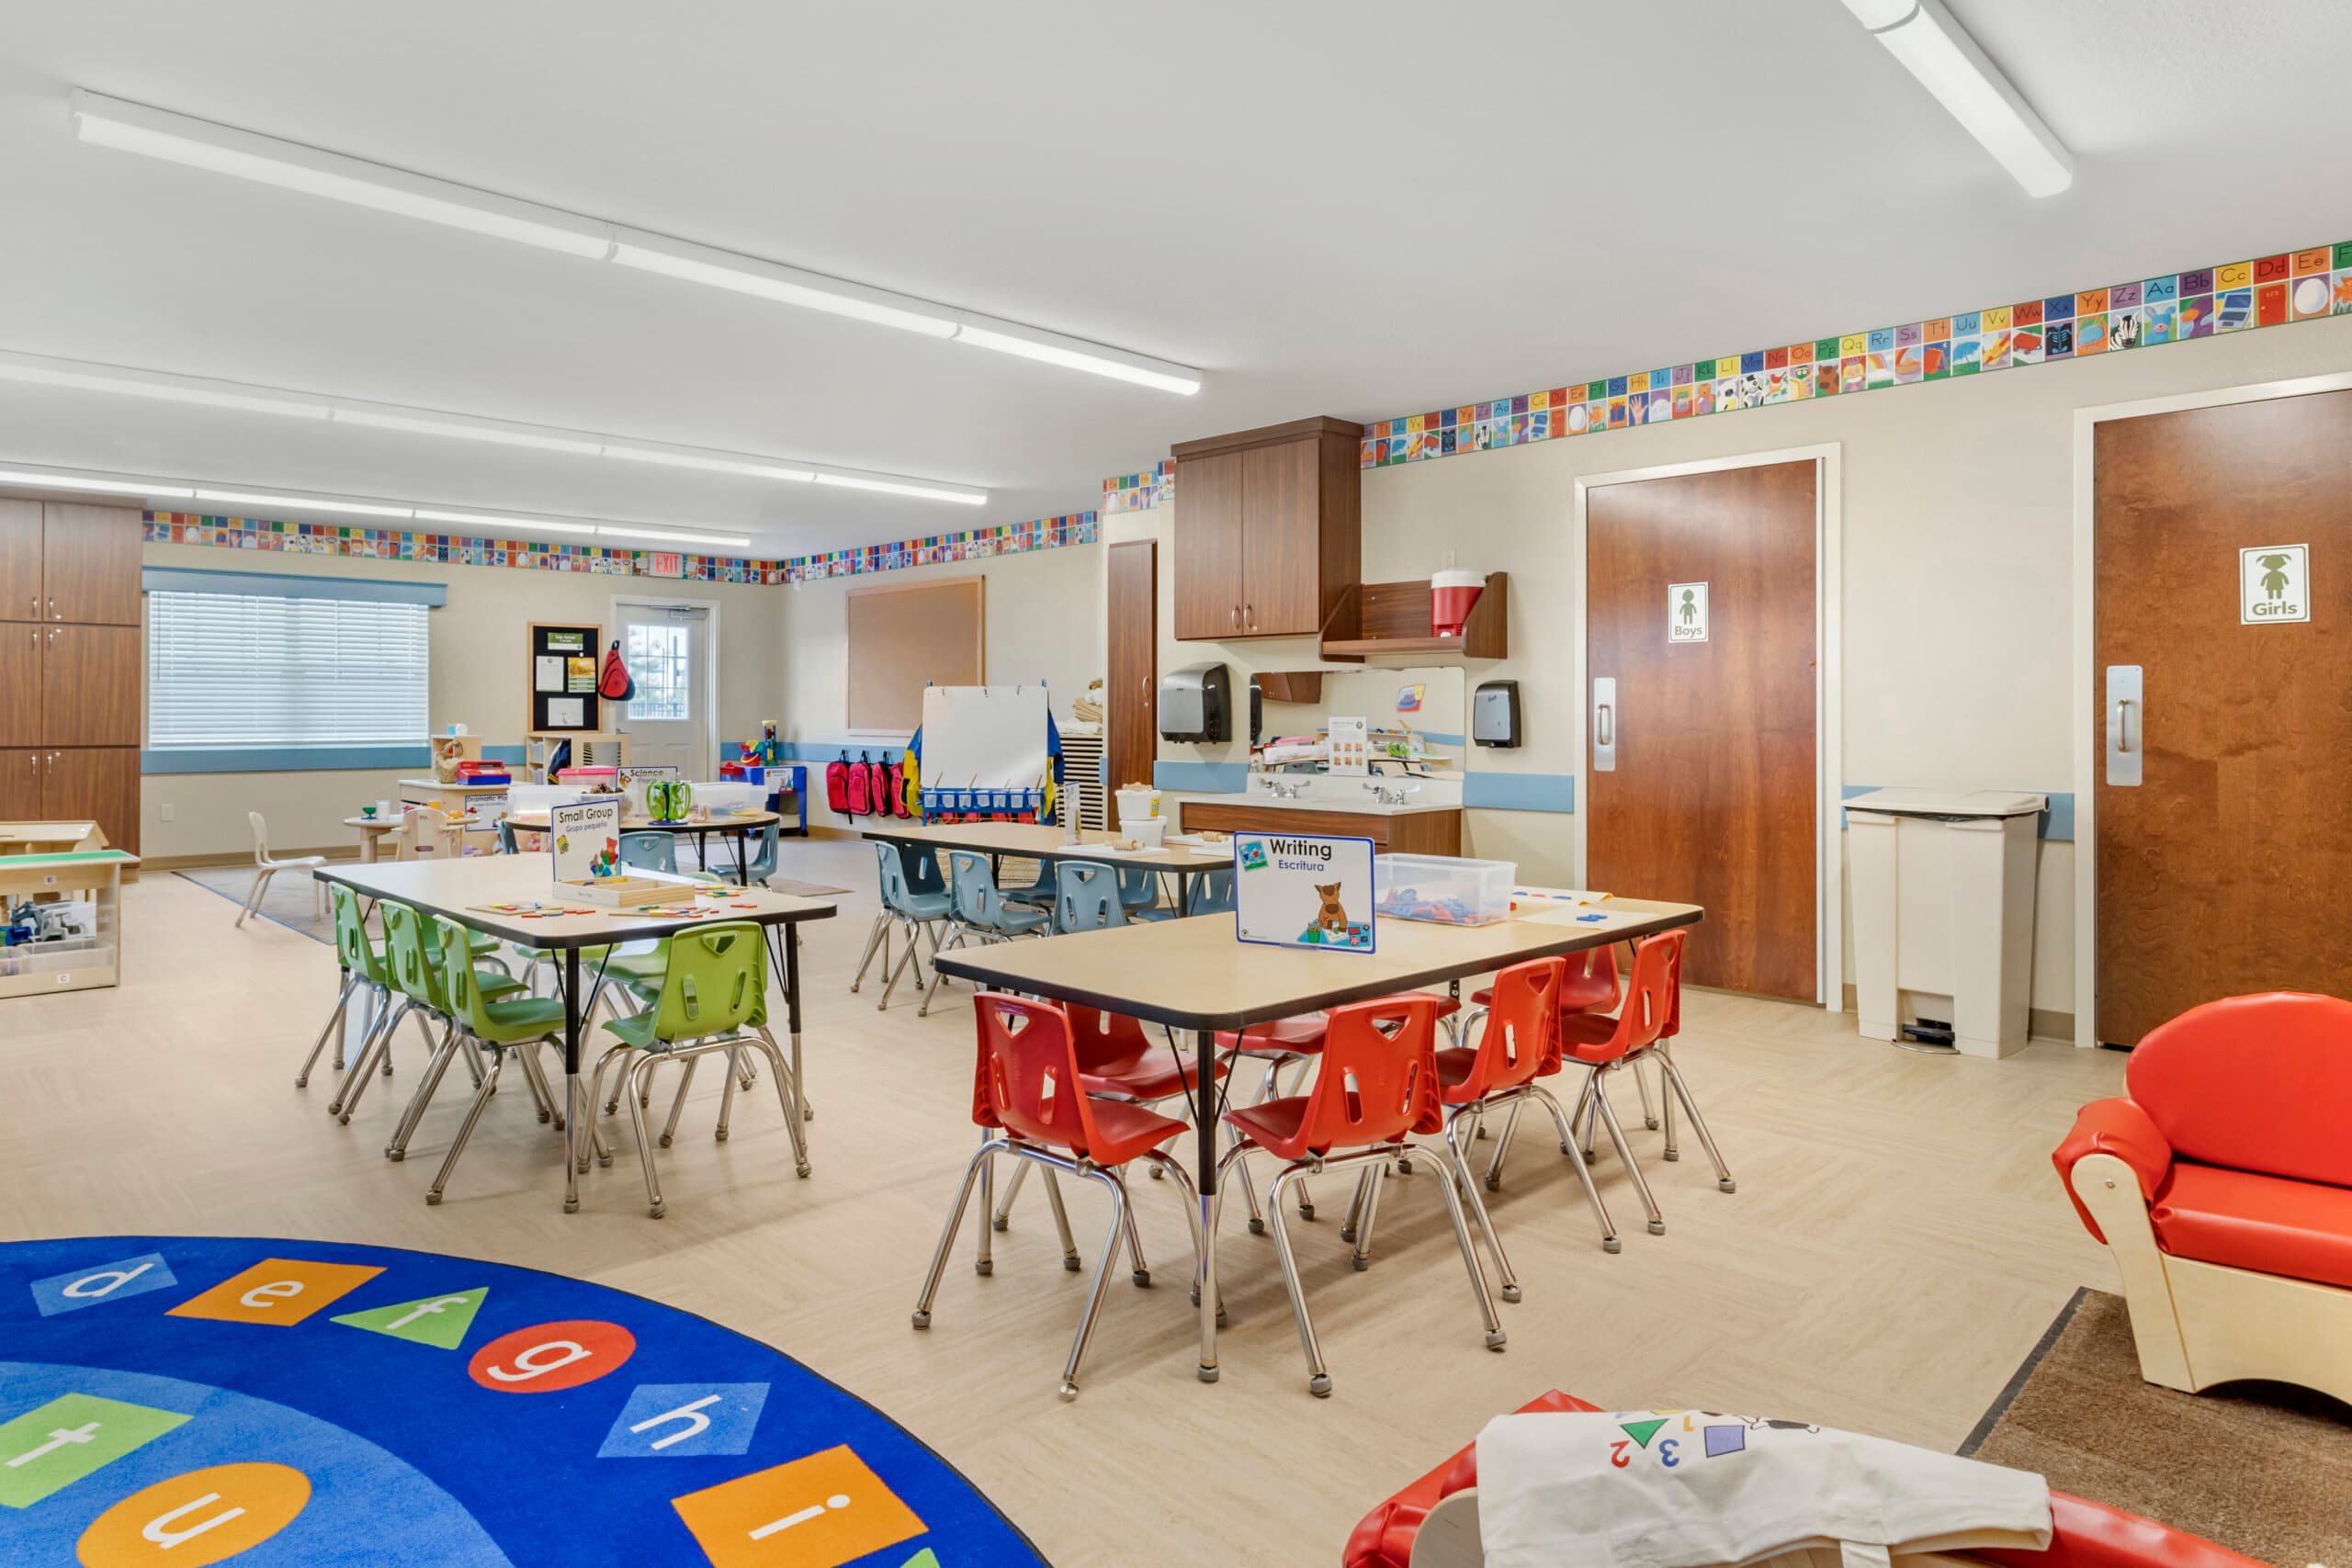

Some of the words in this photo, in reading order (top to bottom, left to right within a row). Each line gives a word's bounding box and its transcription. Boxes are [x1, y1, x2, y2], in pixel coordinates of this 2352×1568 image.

[1495, 402, 1509, 412] Aa
[1631, 376, 1646, 388] Hh
[1956, 319, 1976, 331] Uu
[1987, 311, 2006, 324] Vv
[2013, 305, 2042, 321] Ww
[2082, 294, 2103, 312] Yy
[2115, 288, 2136, 302] Zz
[2147, 282, 2174, 298] Aa
[2184, 273, 2210, 290] Bb
[2221, 267, 2246, 283] Cc
[2258, 258, 2285, 276] Dd
[2299, 253, 2324, 269] Ee
[655, 553, 679, 573] EXIT
[2252, 601, 2298, 615] Girls
[1675, 626, 1702, 637] Boys
[559, 809, 583, 823] Small
[586, 808, 613, 819] Group
[1270, 839, 1332, 861] Writing
[1278, 860, 1324, 872] Escritura
[62, 1263, 154, 1297] d
[240, 1280, 304, 1307] e
[386, 1296, 469, 1330] f
[486, 1340, 593, 1382] g
[630, 1394, 723, 1450] h
[6, 1420, 103, 1469] t
[1610, 1440, 1630, 1468] 2
[1658, 1438, 1679, 1467] 3
[749, 1494, 851, 1540] i
